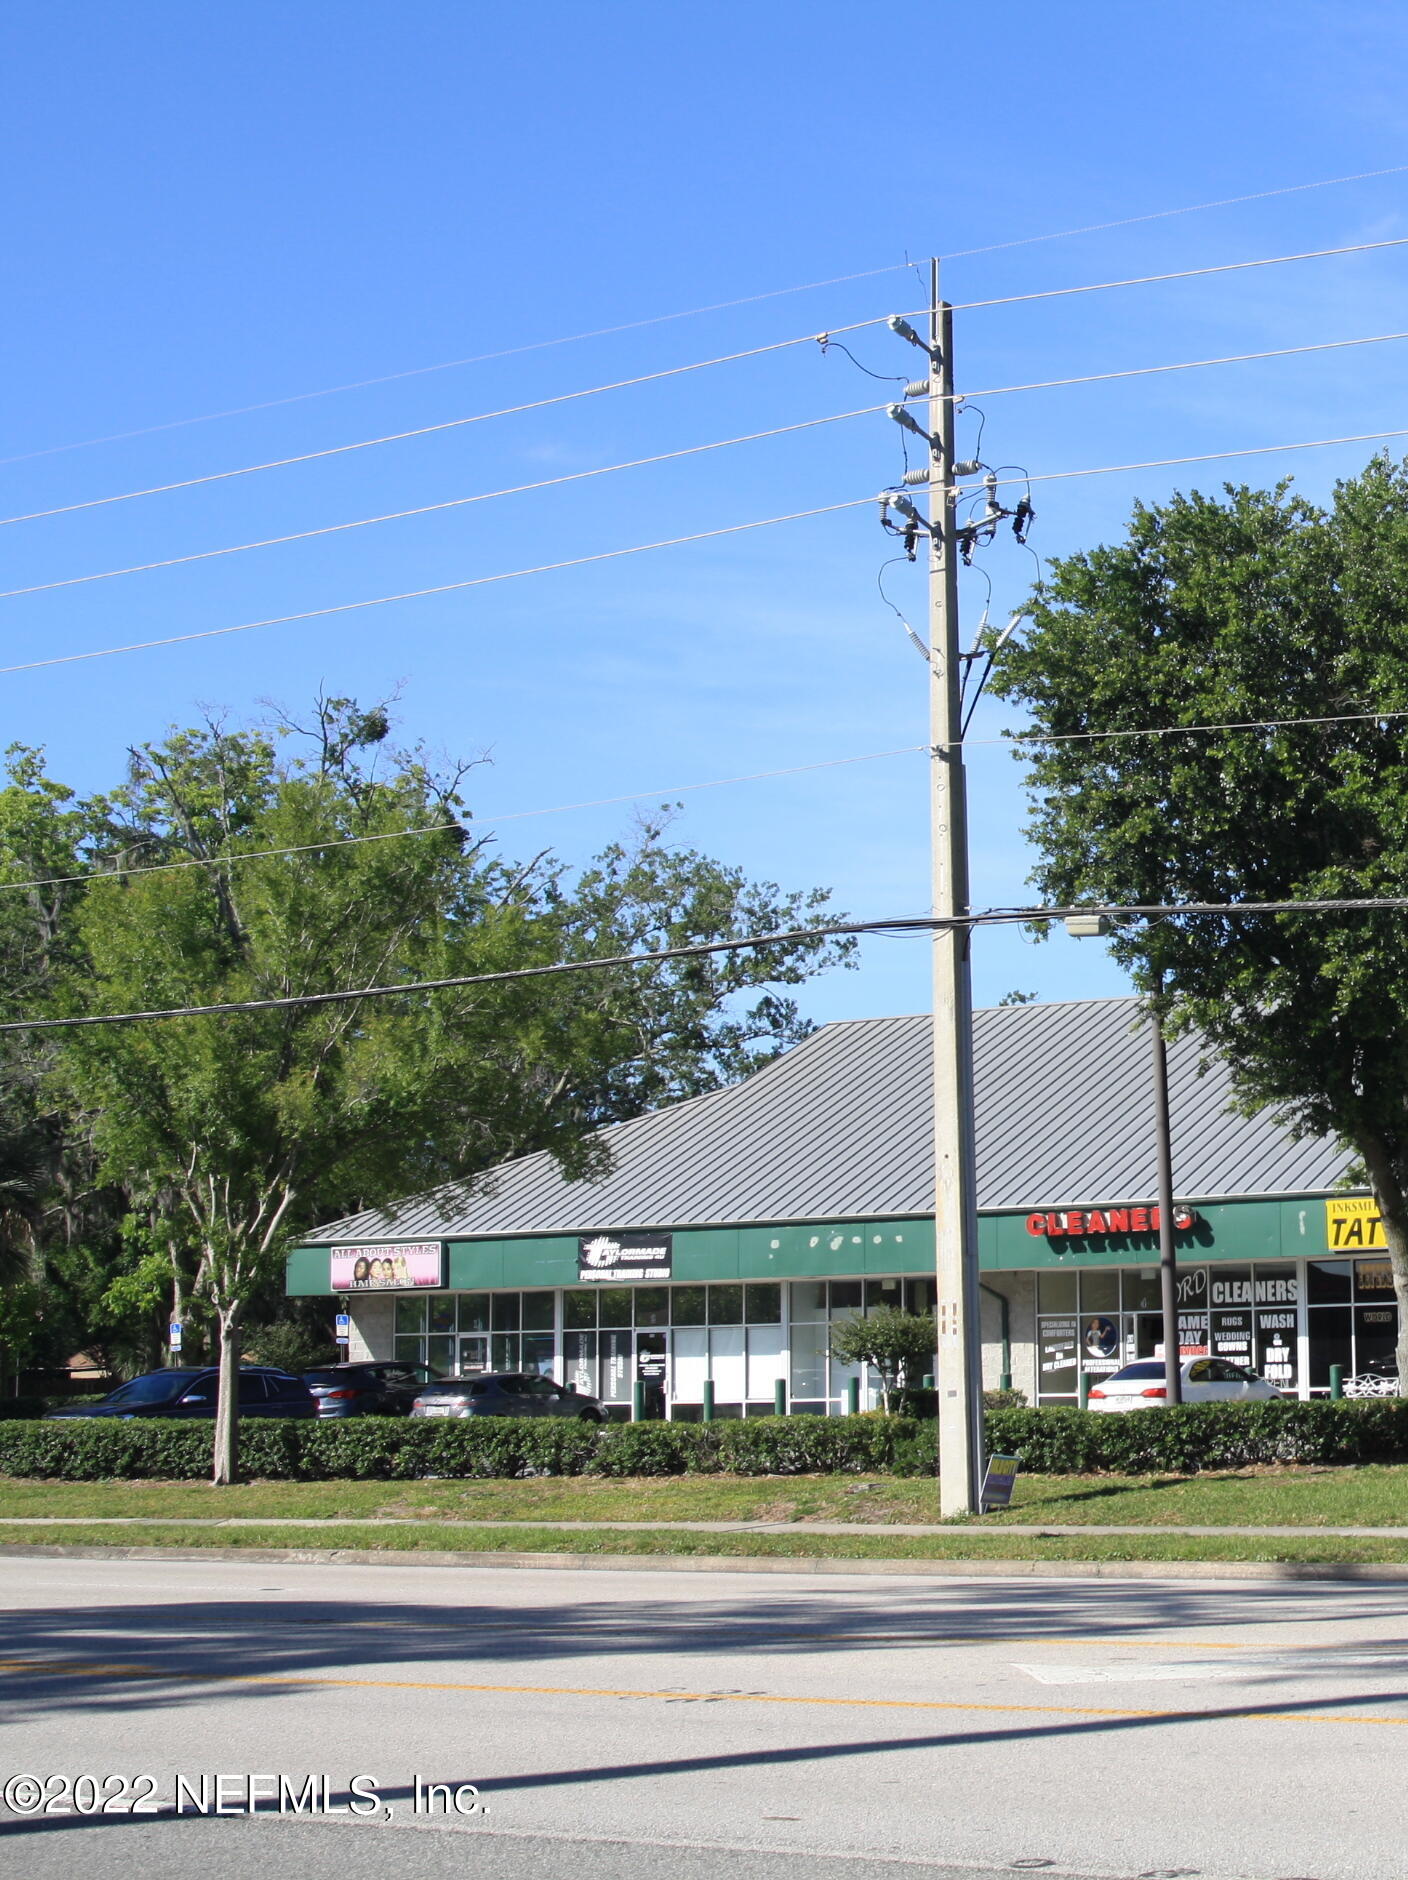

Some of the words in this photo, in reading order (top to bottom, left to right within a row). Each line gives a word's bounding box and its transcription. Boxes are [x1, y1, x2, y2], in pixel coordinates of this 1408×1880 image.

[334, 1250, 353, 1260] ALL
[356, 1247, 392, 1258] ABOUT
[393, 1244, 437, 1256] STYLES
[644, 1267, 671, 1278] STUDIO
[350, 1280, 378, 1288] HAIR
[1212, 1279, 1298, 1304] CLEANERS
[1178, 1315, 1208, 1329] AME
[1221, 1316, 1243, 1326] RUGS
[1260, 1314, 1295, 1329] WASH
[1214, 1331, 1251, 1341] WEDDING
[1272, 1333, 1283, 1346] &
[1217, 1341, 1248, 1352] GOWNS
[1265, 1347, 1290, 1362] DRY
[1264, 1364, 1292, 1380] FOLD
[1265, 1379, 1290, 1388] PEN
